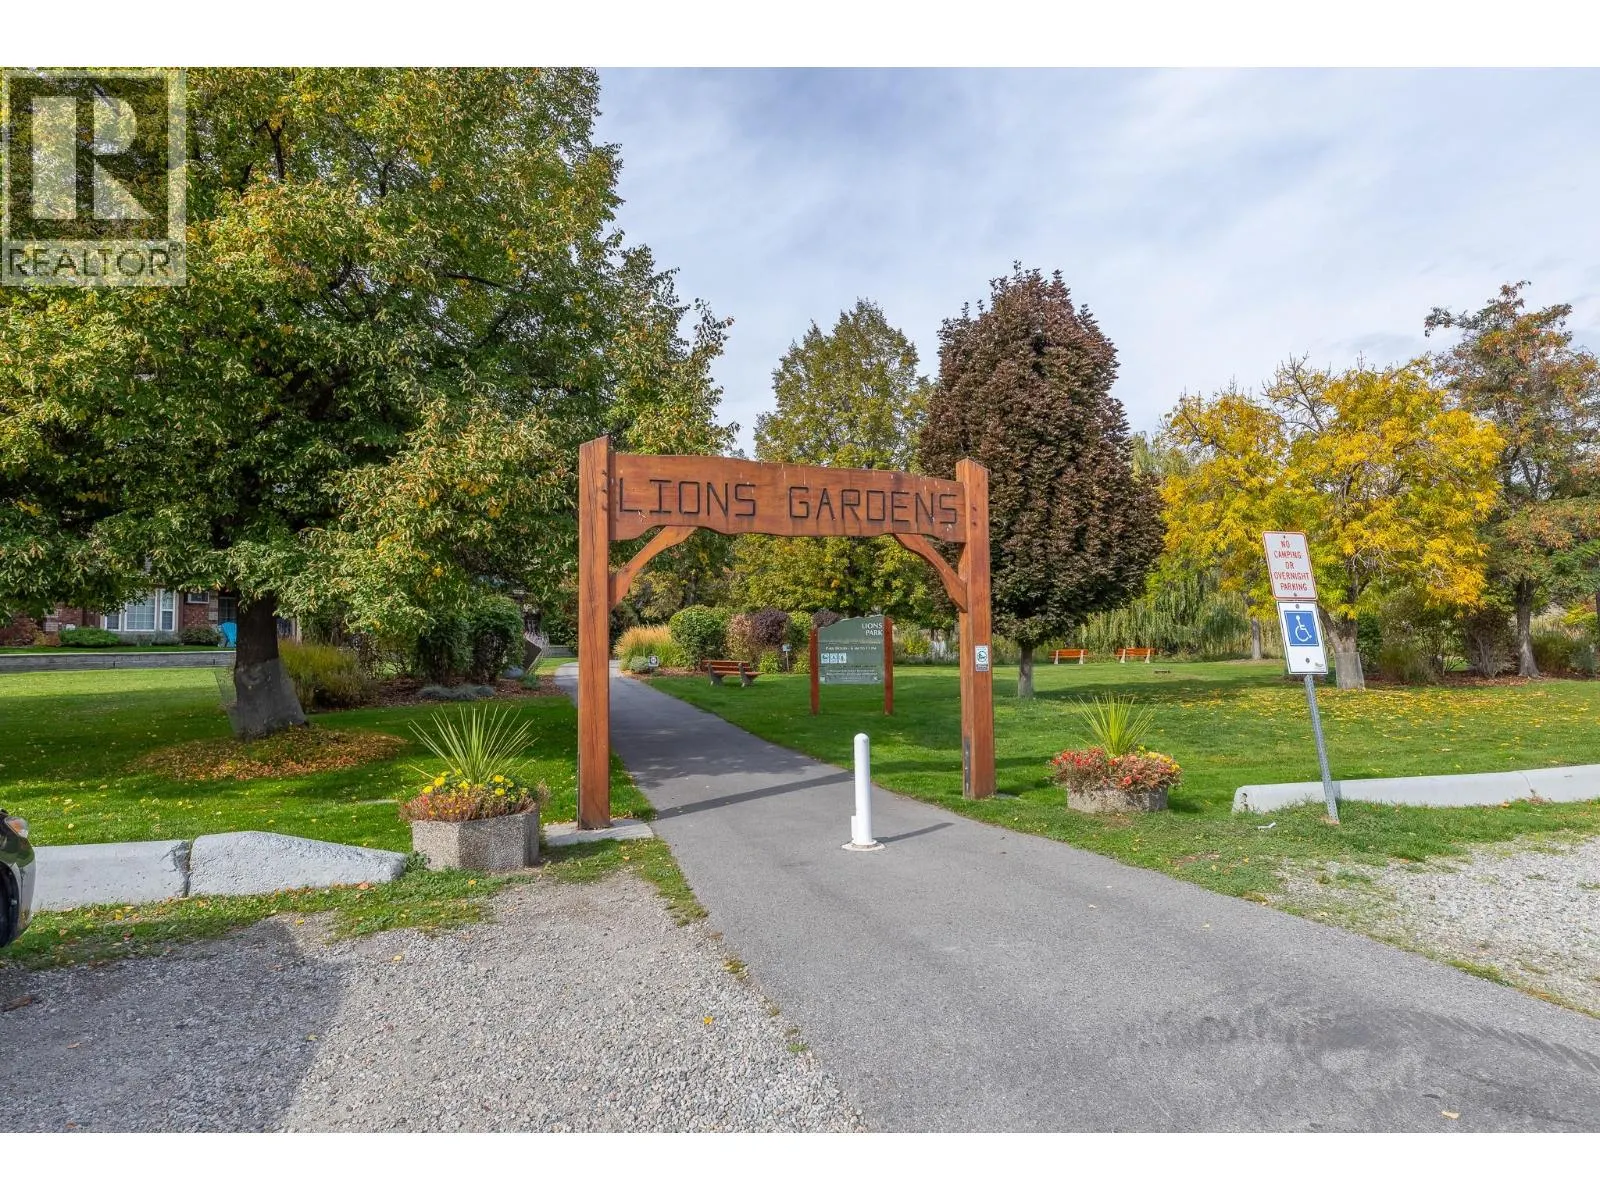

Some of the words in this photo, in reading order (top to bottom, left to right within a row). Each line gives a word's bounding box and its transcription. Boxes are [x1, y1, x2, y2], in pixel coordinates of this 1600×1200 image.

[618, 477, 757, 518] LIONS
[788, 486, 958, 526] GARDENS
[1280, 540, 1291, 549] NO
[1273, 550, 1302, 559] CAMPING
[1285, 561, 1295, 570] OR
[1273, 572, 1310, 581] OVERNIGHT
[1280, 582, 1308, 592] PARKING
[861, 622, 883, 630] LIONS
